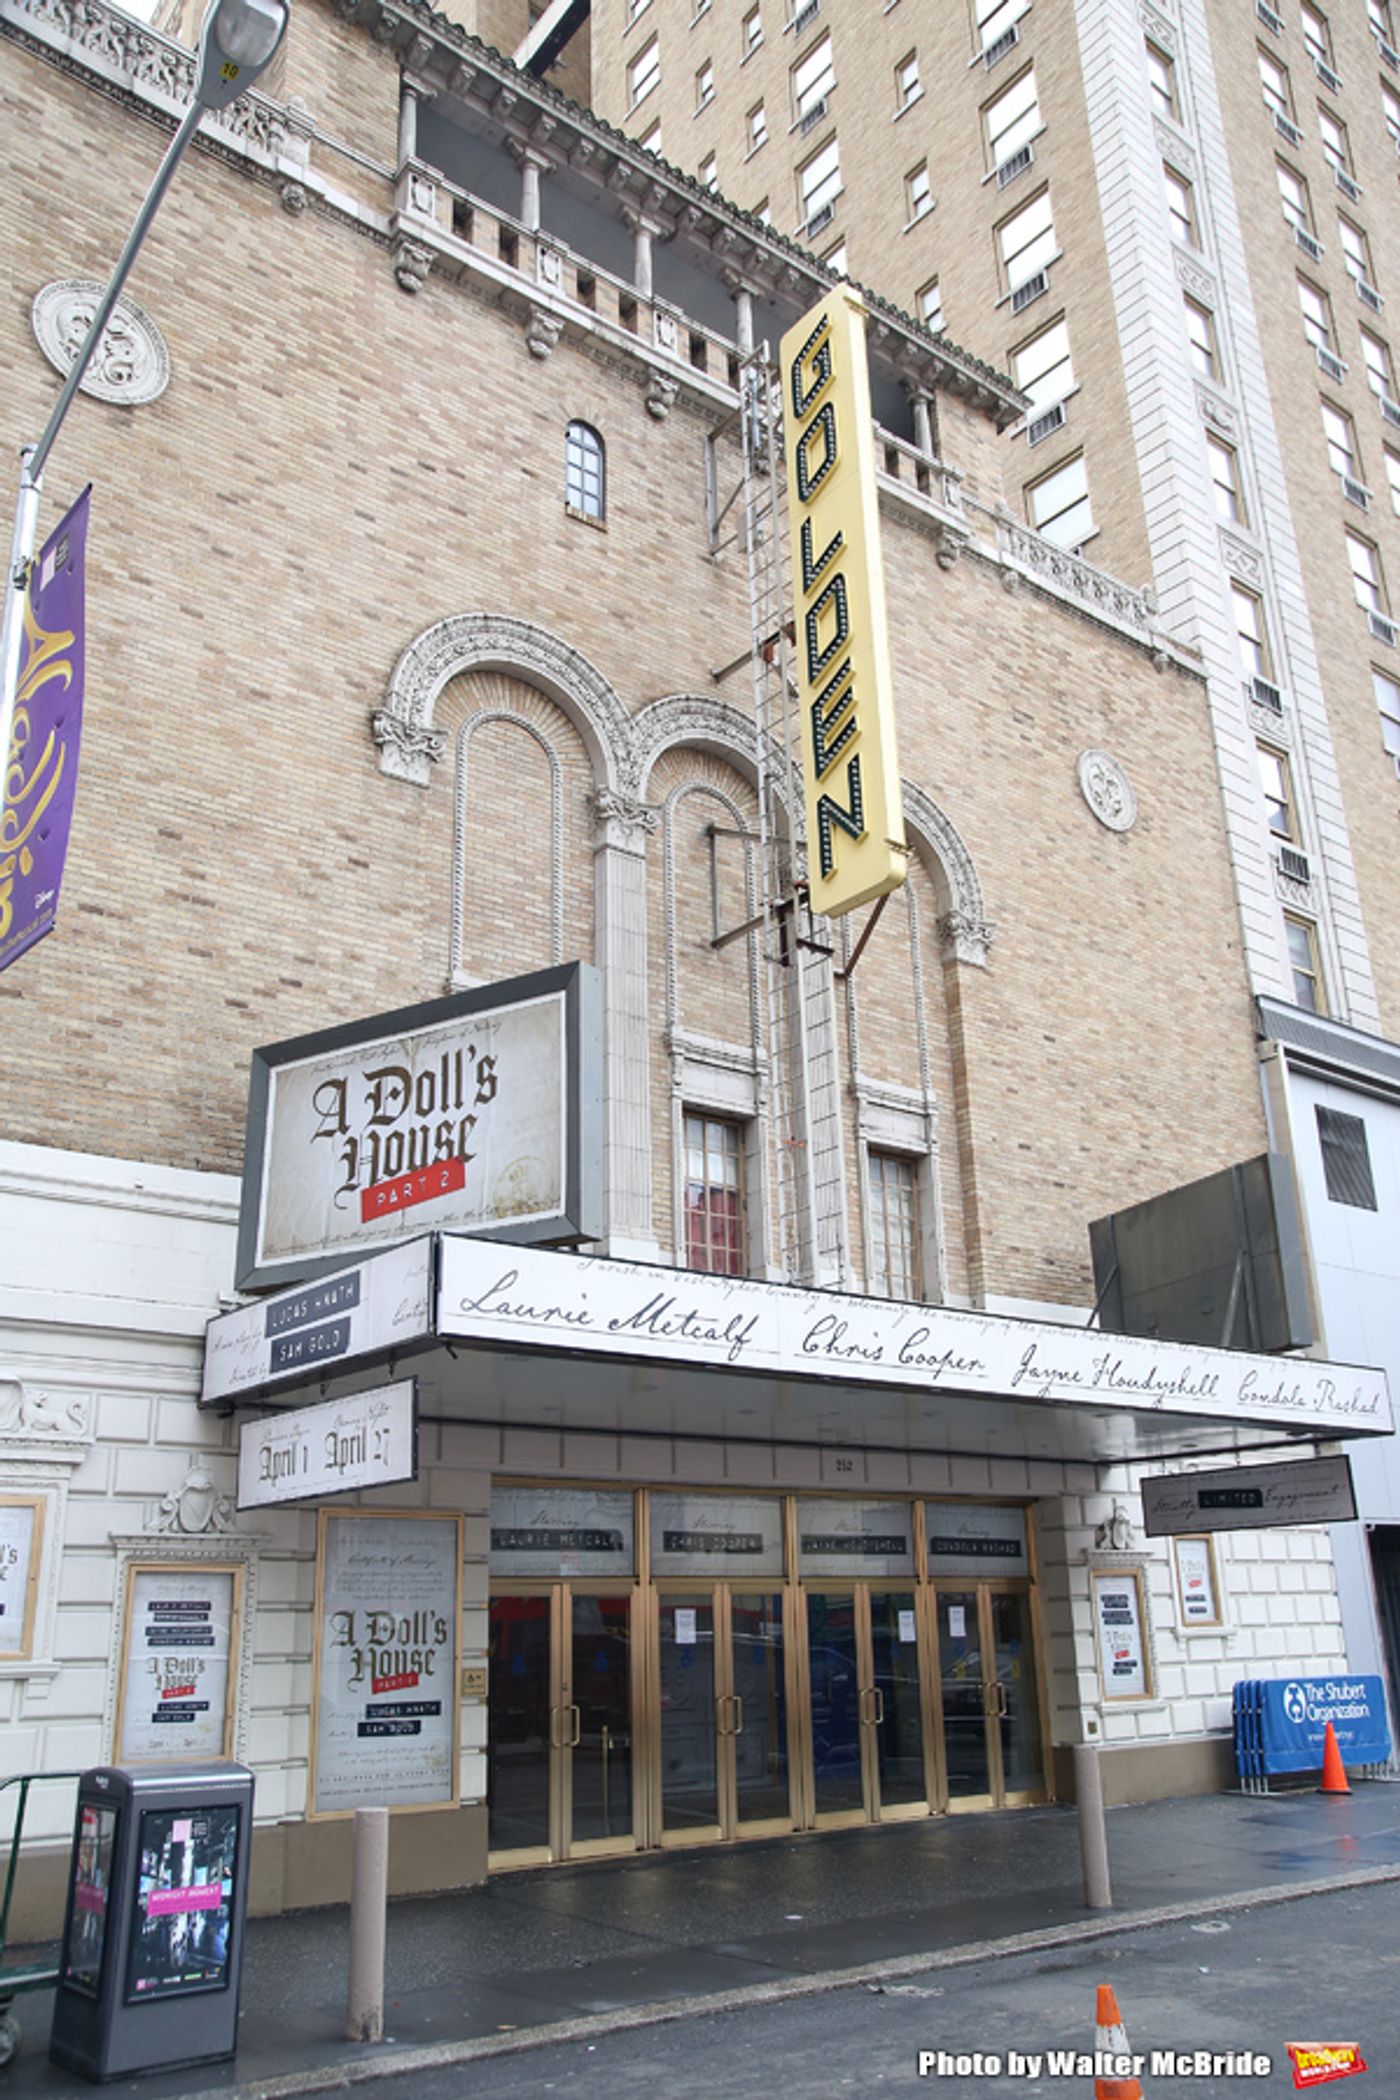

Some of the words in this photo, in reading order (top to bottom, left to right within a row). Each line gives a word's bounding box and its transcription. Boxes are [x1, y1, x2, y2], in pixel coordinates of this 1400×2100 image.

[792, 314, 867, 880] GOLDEN
[311, 1077, 350, 1143] A
[363, 1045, 498, 1126] Doll's
[334, 1113, 478, 1210] House
[376, 1176, 428, 1207] PART
[440, 1170, 450, 1188] 2
[461, 1270, 592, 1326] Laurie
[608, 1292, 759, 1360] Metcalf
[279, 1342, 302, 1362] SAM
[309, 1329, 341, 1354] GOLD
[802, 1315, 884, 1361] Chris
[899, 1328, 985, 1382] Cooper
[1012, 1344, 1083, 1399] Jayne
[1091, 1353, 1219, 1409] Houdyshell
[259, 1442, 296, 1487] April
[303, 1445, 308, 1474] 1
[324, 1426, 367, 1476] April
[373, 1428, 391, 1467] 27
[1265, 1484, 1339, 1508] Engagement
[500, 1533, 550, 1546] LAURIE
[329, 1610, 356, 1648] A
[365, 1609, 447, 1646] Doll's
[347, 1647, 436, 1692] House
[1304, 1682, 1325, 1701] The
[1325, 1681, 1367, 1700] Shubert
[1307, 1703, 1371, 1725] Organization
